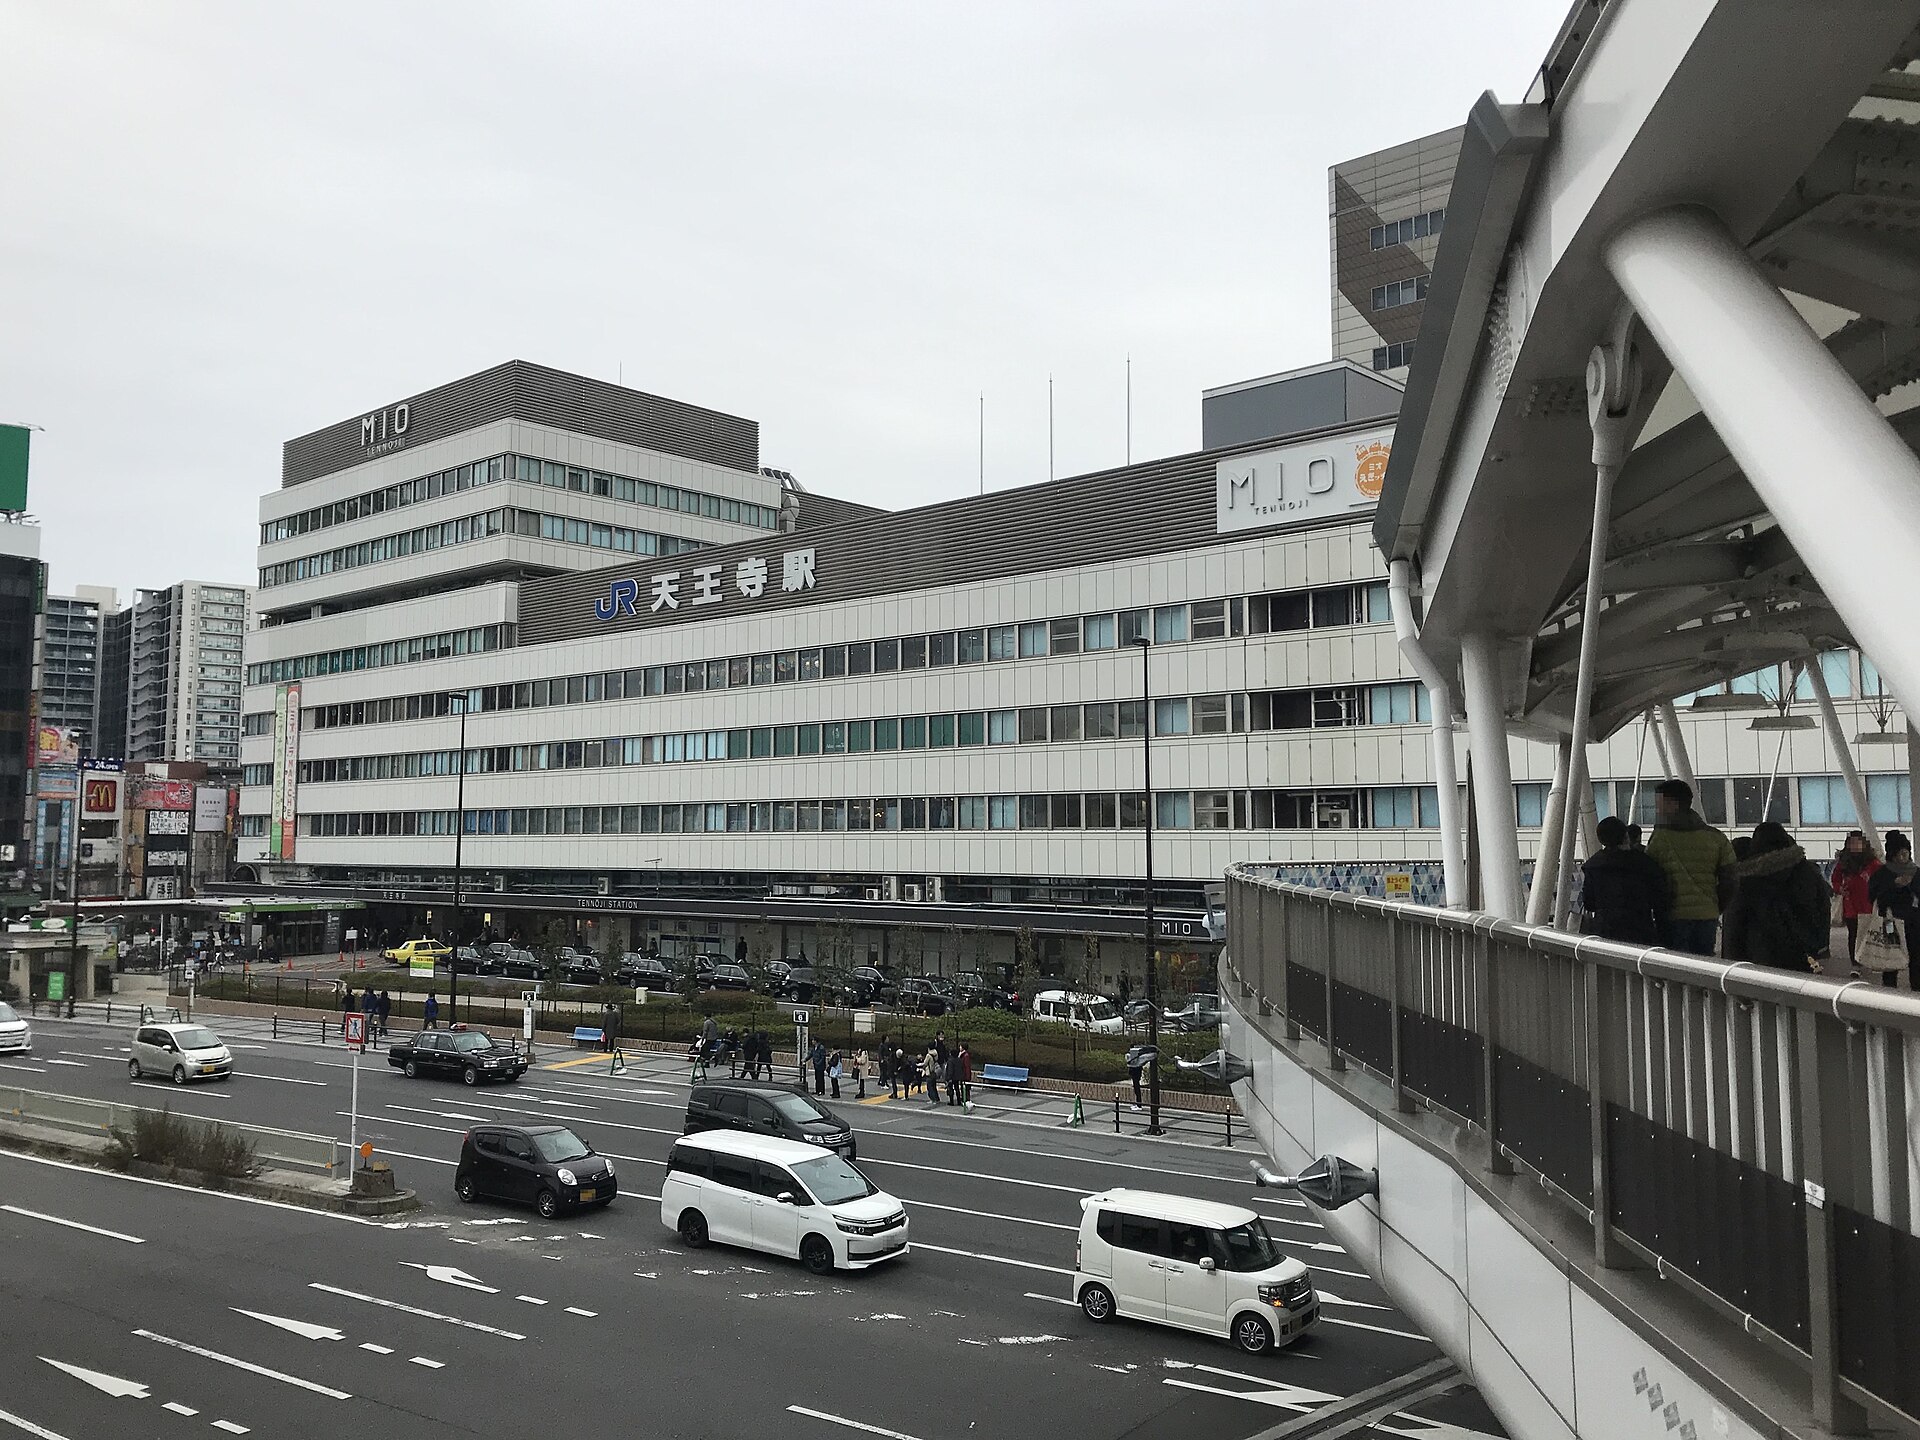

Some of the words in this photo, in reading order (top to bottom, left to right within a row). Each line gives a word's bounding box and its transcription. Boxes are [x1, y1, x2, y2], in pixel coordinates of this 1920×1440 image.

[361, 403, 409, 446] MIO
[1228, 454, 1335, 509] MIO
[1254, 499, 1309, 515] TENNOJI
[594, 578, 638, 621] JR
[650, 547, 817, 613] 天王寺駅
[608, 900, 638, 909] STATION
[1161, 921, 1191, 935] MIO
